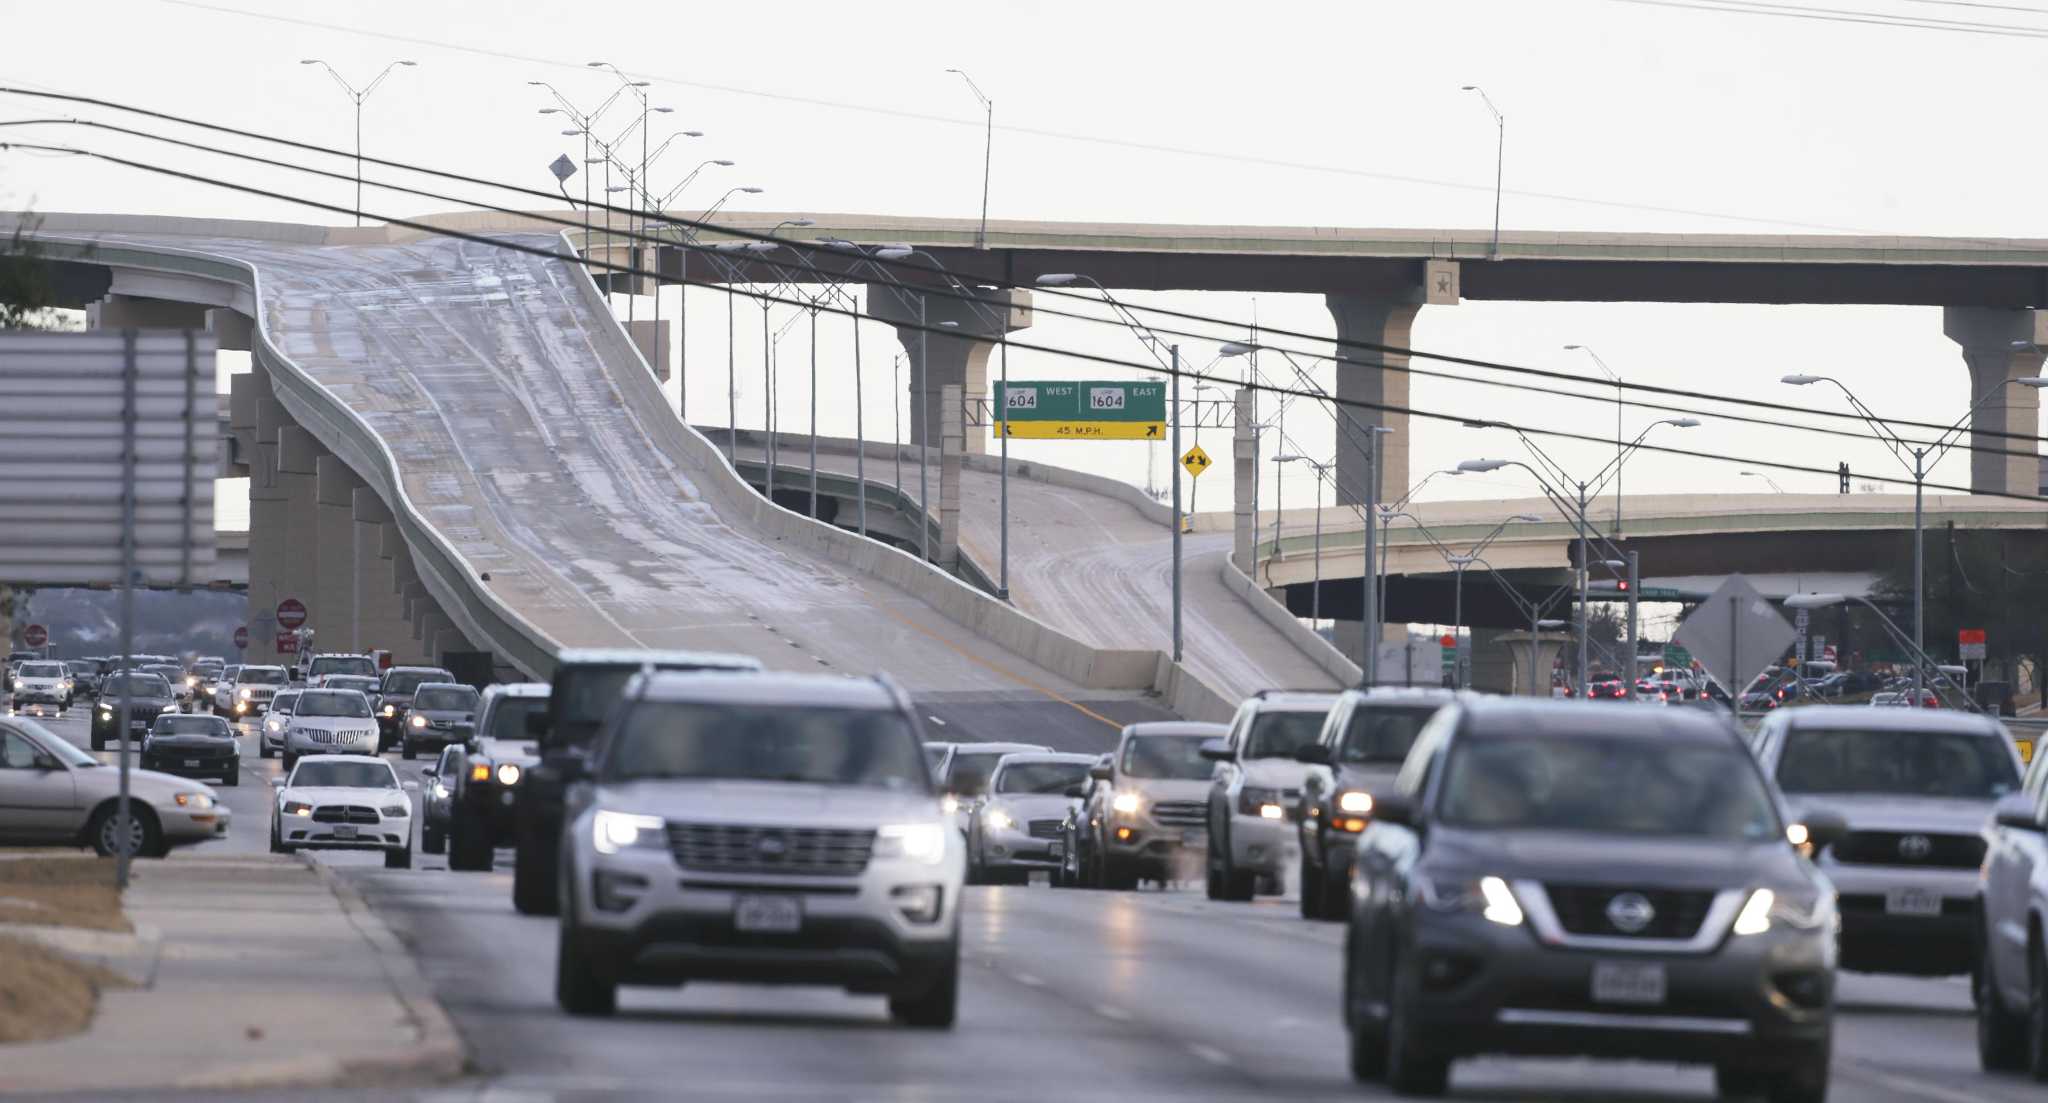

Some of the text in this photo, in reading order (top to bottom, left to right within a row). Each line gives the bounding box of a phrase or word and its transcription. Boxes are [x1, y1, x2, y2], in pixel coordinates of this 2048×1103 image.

[1046, 386, 1073, 396] WEST
[1132, 387, 1157, 397] EAST
[1006, 395, 1034, 407] 604
[1092, 395, 1122, 408] 1604
[1056, 426, 1071, 435] 45
